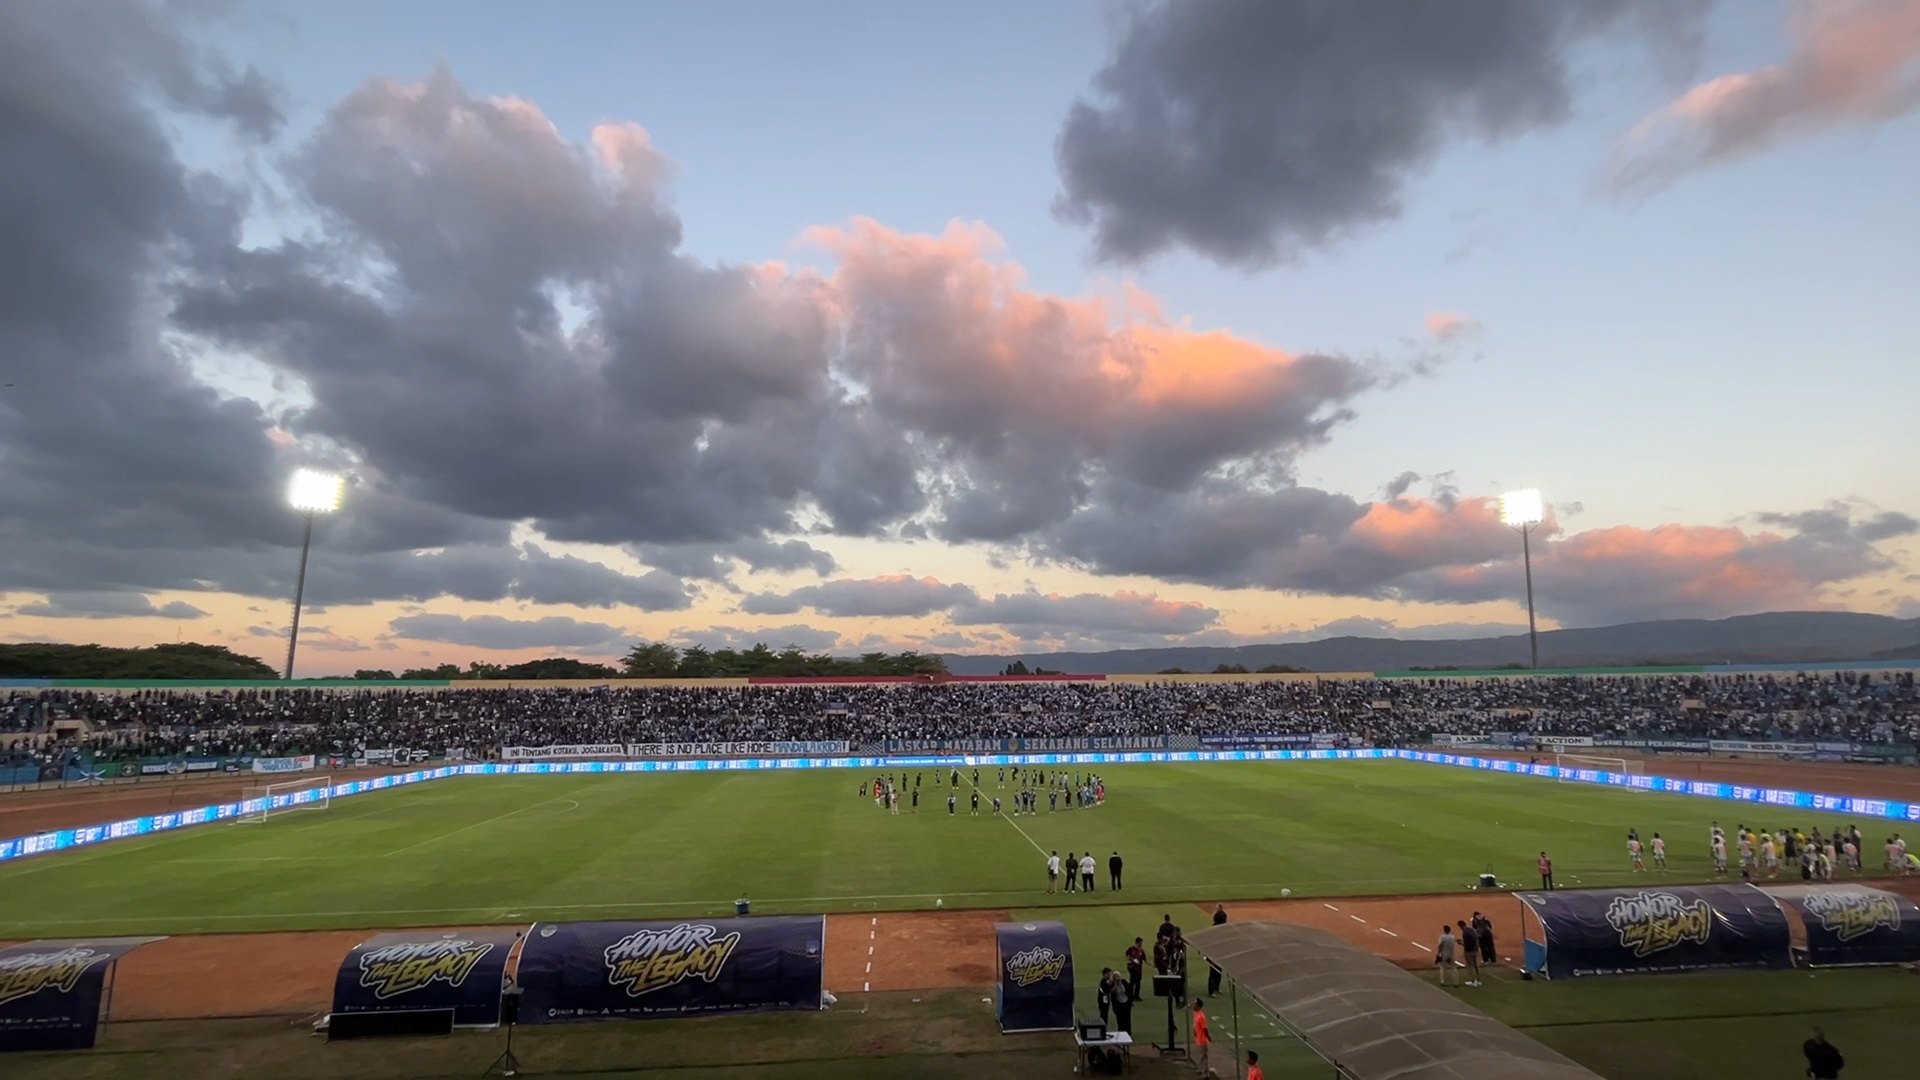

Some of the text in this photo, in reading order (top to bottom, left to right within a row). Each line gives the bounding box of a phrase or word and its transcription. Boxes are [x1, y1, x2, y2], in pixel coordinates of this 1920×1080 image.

[632, 744, 662, 755] THERE
[666, 744, 675, 755] IS
[678, 744, 692, 755] NO
[694, 743, 723, 754] PLACE
[725, 743, 745, 754] LIKE
[747, 742, 771, 753] HOME
[889, 739, 1000, 751] LASKAR MATARAM
[1024, 736, 1164, 750] SEKARANG SELAMANYA
[1612, 893, 1681, 926] HONOR
[367, 940, 464, 965] HONOR
[611, 925, 710, 961] HONOR
[364, 946, 492, 994] THE LEGACY
[614, 935, 737, 992] THE LEGACY
[1008, 948, 1053, 970] HONOR
[1020, 955, 1065, 985] LEGACY
